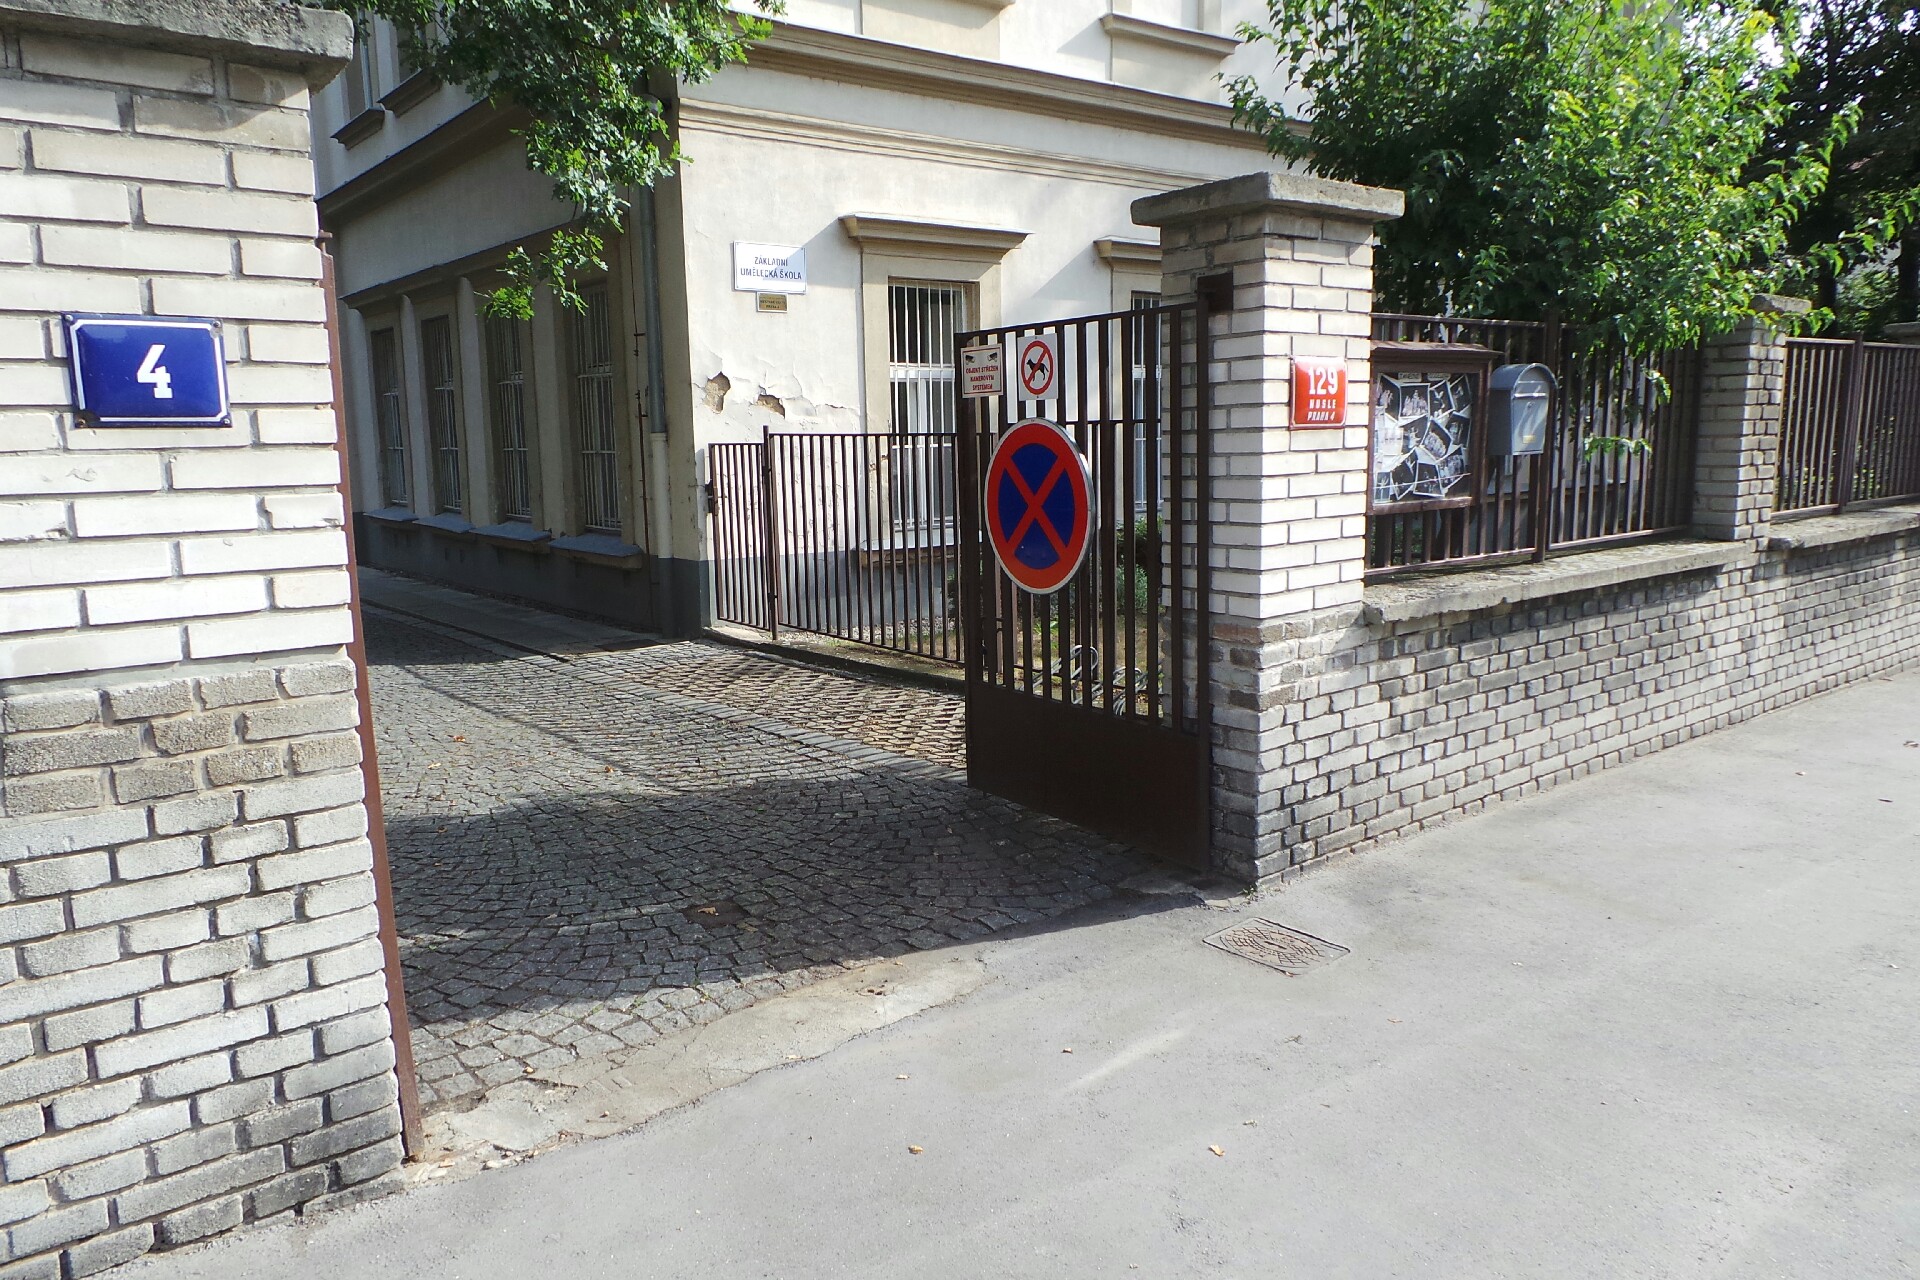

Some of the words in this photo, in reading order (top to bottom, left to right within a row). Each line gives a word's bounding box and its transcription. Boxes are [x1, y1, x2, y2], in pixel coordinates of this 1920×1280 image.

[754, 255, 788, 267] ZÁKLADNÍ
[740, 267, 778, 279] UMĚLECKÁ
[779, 269, 802, 280] ŠKOLA
[137, 344, 173, 399] 4
[1308, 366, 1338, 395] 129
[1309, 398, 1336, 409] NUSLE
[1308, 411, 1329, 421] PRAHA
[1330, 411, 1335, 421] 4
